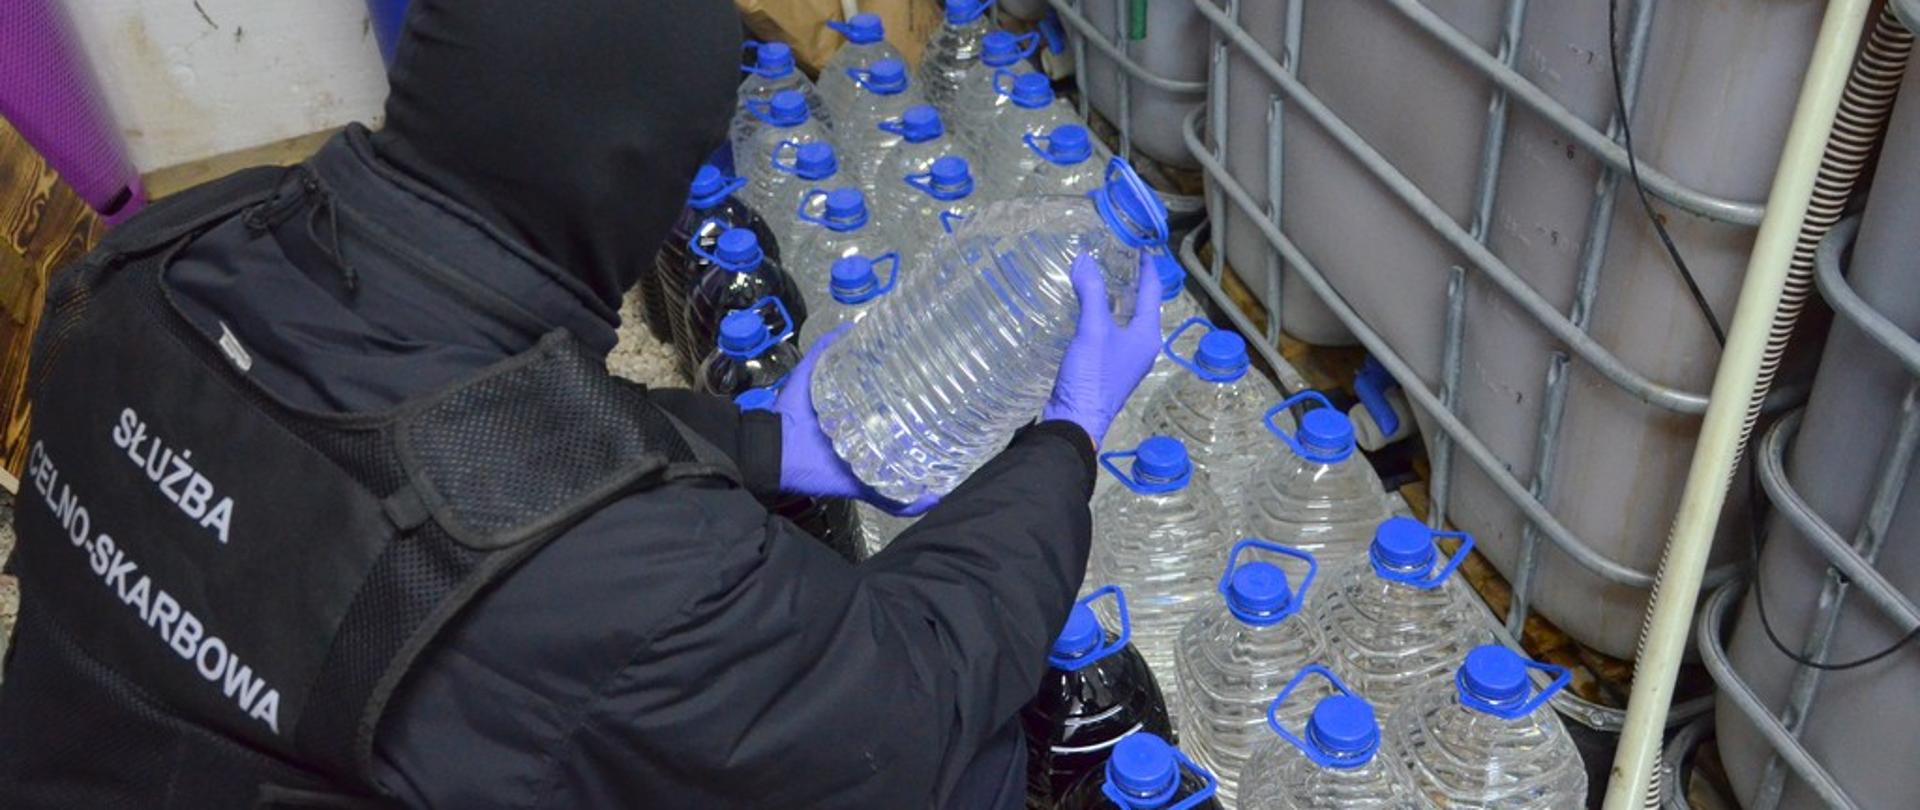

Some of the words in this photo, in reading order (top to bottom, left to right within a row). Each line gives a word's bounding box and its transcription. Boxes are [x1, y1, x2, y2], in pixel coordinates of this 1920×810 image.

[1566, 144, 1576, 160] 6
[113, 407, 234, 544] SŁUŻBA
[28, 440, 280, 734] CELNO-SKARBOWA
